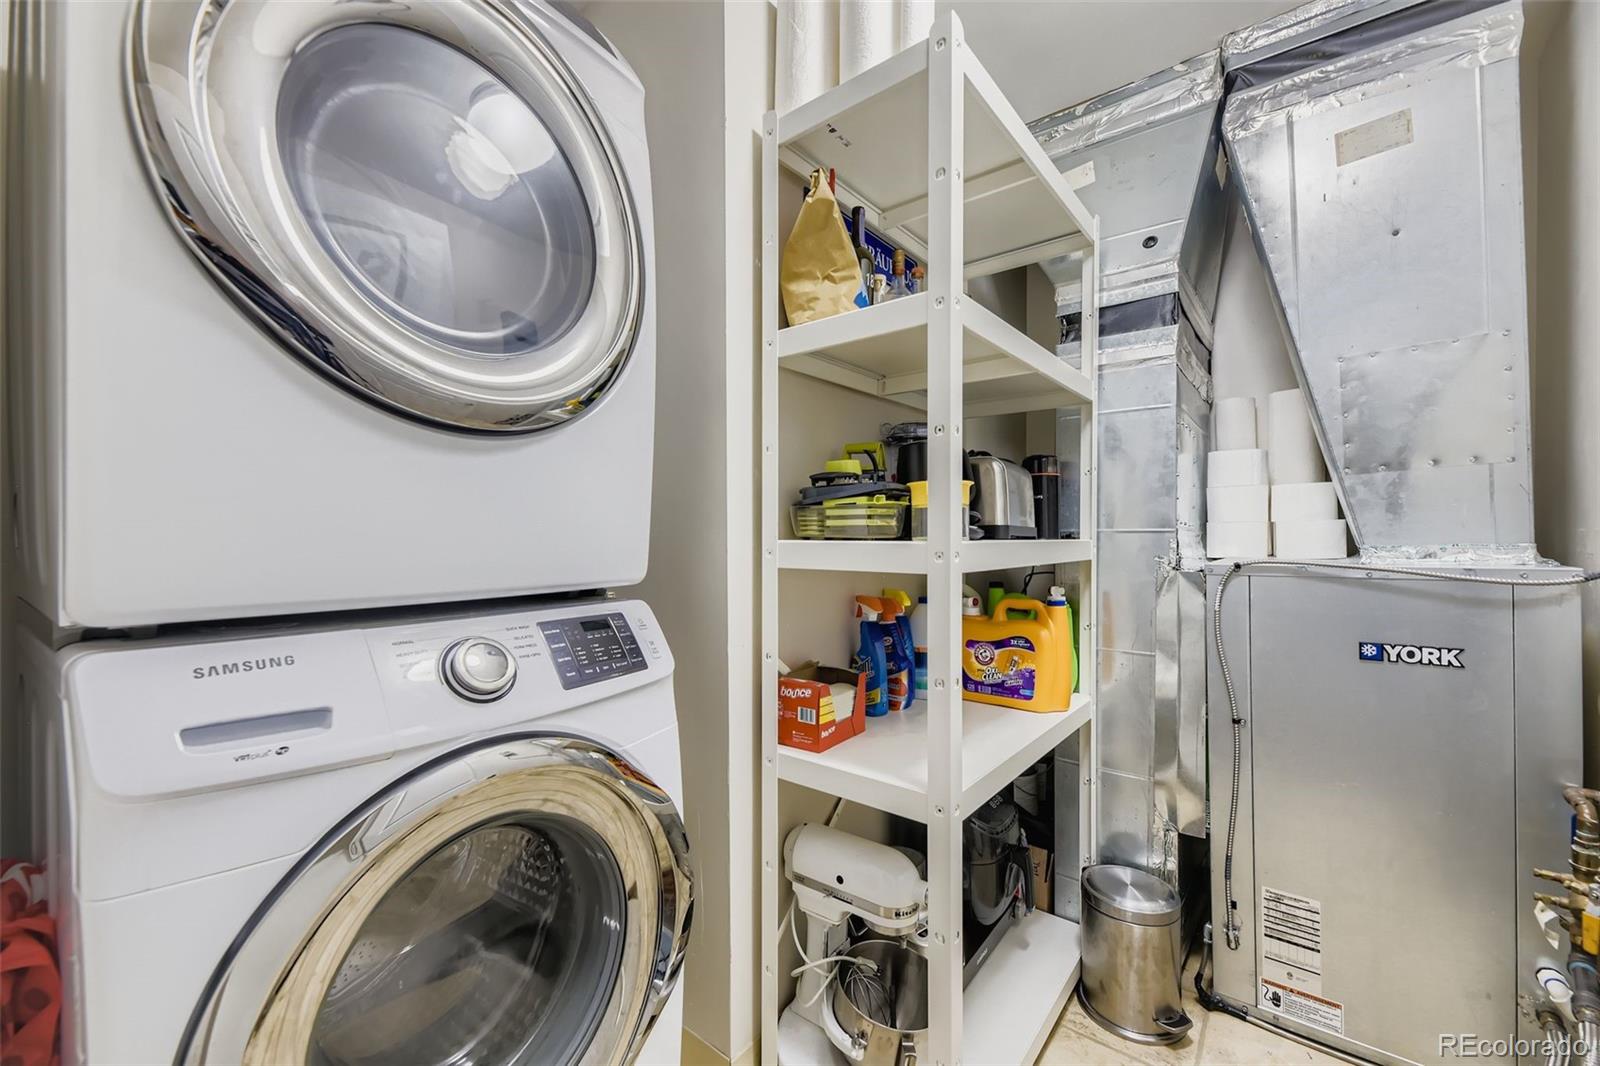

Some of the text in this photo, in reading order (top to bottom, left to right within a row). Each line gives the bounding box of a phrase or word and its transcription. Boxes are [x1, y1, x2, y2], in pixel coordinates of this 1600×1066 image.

[1383, 644, 1462, 667] YORK
[193, 655, 295, 680] SAMSUNG
[780, 685, 812, 698] bounce
